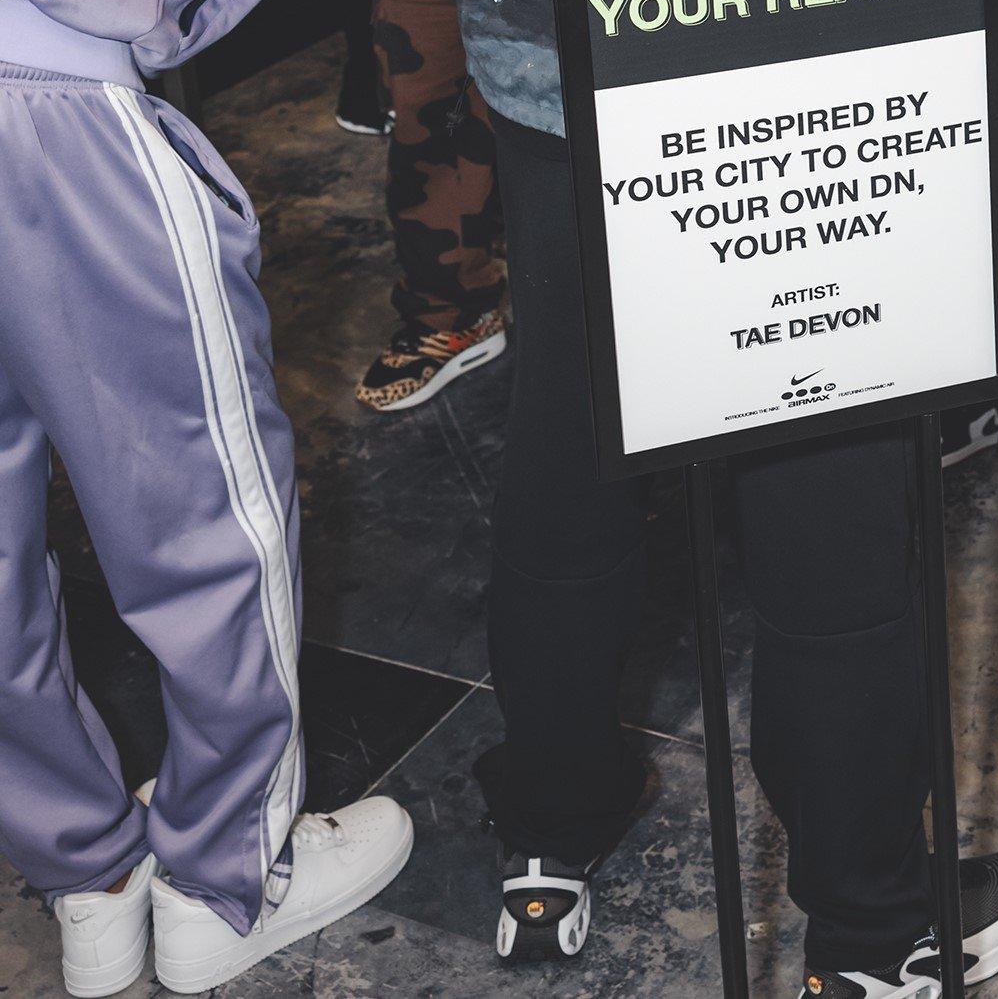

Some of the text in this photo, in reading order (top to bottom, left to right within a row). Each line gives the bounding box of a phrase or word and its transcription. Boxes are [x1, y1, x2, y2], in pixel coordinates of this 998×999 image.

[661, 91, 929, 158] BE INSPIRED BY
[602, 119, 983, 205] YOUR CITY TO CREATE
[670, 168, 926, 233] YOUR OWN DN,
[710, 210, 893, 264] YOUR WAY.
[771, 282, 841, 308] ARTIST:
[729, 303, 882, 350] TAE DEVON
